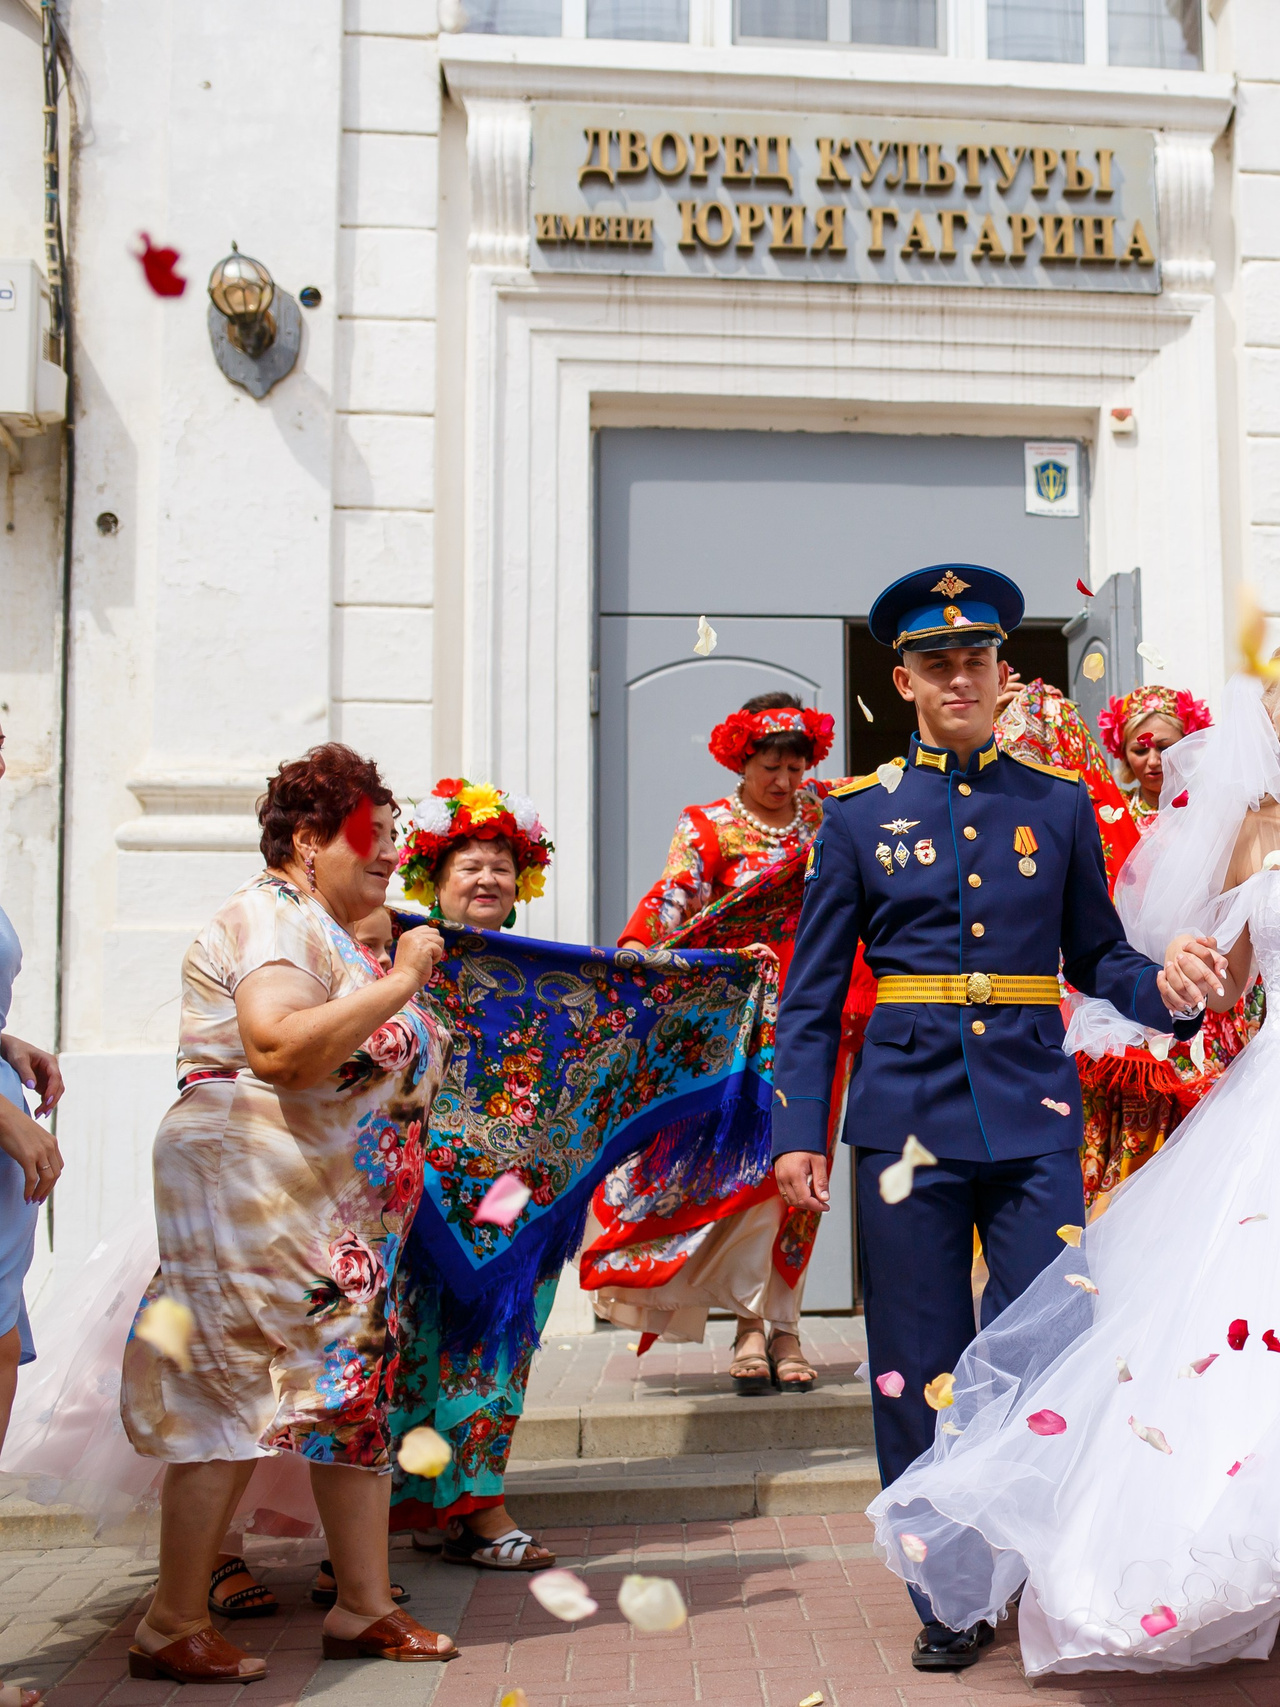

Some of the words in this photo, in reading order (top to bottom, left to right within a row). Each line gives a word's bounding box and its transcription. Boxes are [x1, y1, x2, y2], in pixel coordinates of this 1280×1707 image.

[577, 127, 794, 195] ДВОРЕЦ
[816, 138, 1114, 198] КУЛЬТУРЫ
[535, 213, 653, 247] ИМЕНИ
[678, 200, 847, 254] ЮРИЯ
[868, 207, 1155, 265] ГАГАРИНА
